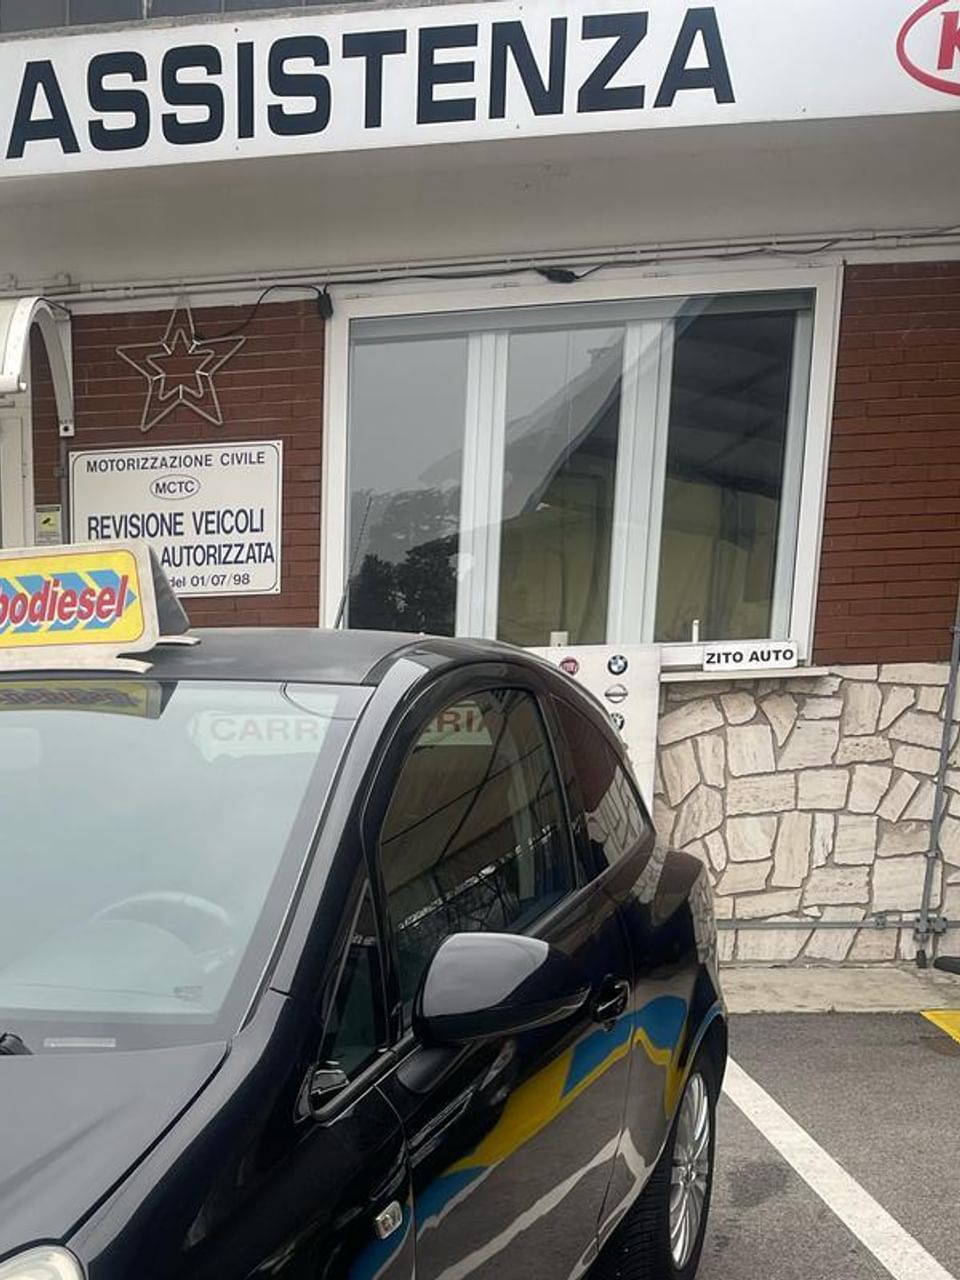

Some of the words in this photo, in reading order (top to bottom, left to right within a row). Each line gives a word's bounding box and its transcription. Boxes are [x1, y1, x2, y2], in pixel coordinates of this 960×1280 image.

[5, 6, 735, 159] ASSISTENZA
[87, 454, 213, 472] MOTORIZZAZIONE
[220, 451, 266, 466] CIVILE
[154, 481, 196, 494] MCTC
[88, 512, 185, 540] REVISIONE
[192, 508, 265, 535] VEICOLI
[161, 542, 275, 567] AUTORIZZATA
[190, 573, 251, 587] 01/07/98
[705, 651, 744, 665] ZITO
[748, 649, 795, 663] AUTO
